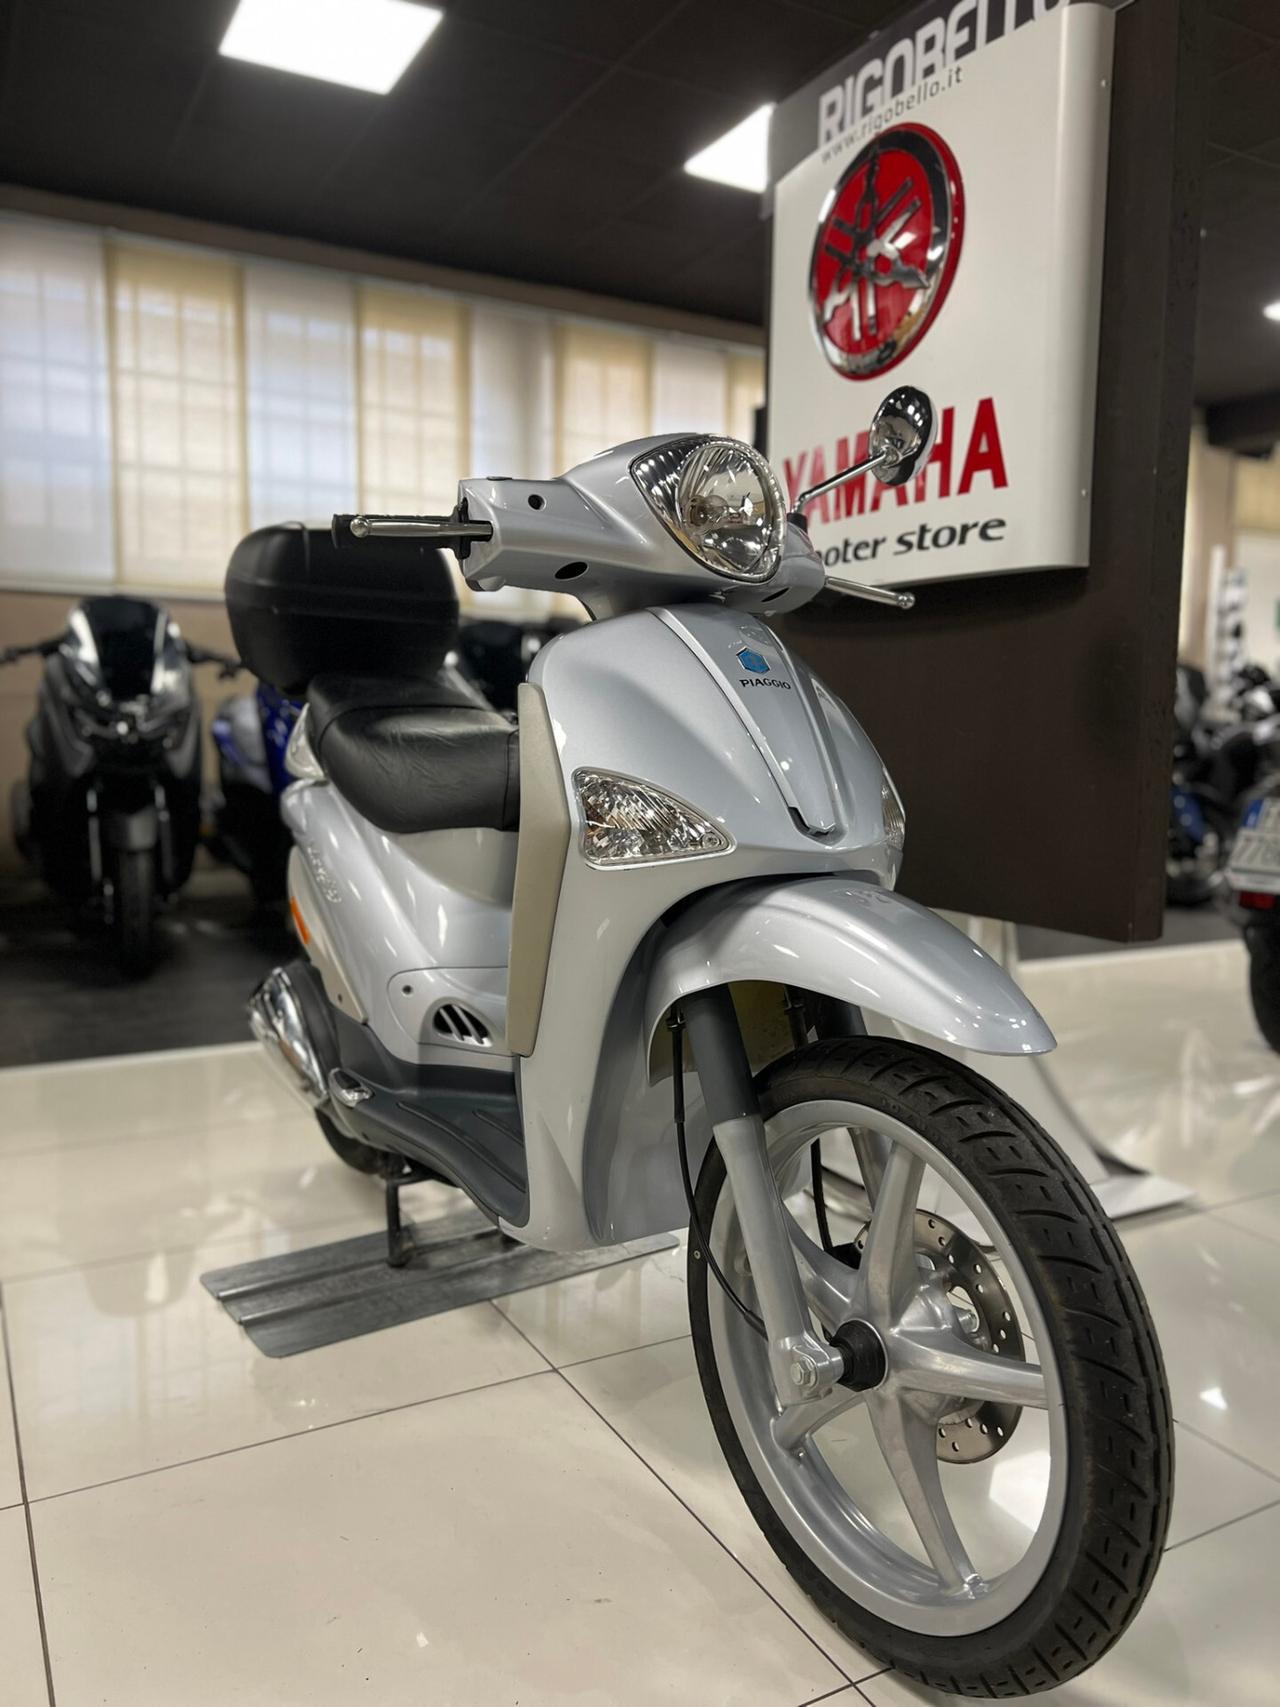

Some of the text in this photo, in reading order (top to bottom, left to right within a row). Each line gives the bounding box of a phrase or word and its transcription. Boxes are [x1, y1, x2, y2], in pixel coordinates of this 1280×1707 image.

[821, 66, 963, 163] www.rigobello.it
[815, 517, 1007, 567] oter store
[739, 677, 792, 691] PIAGGIO
